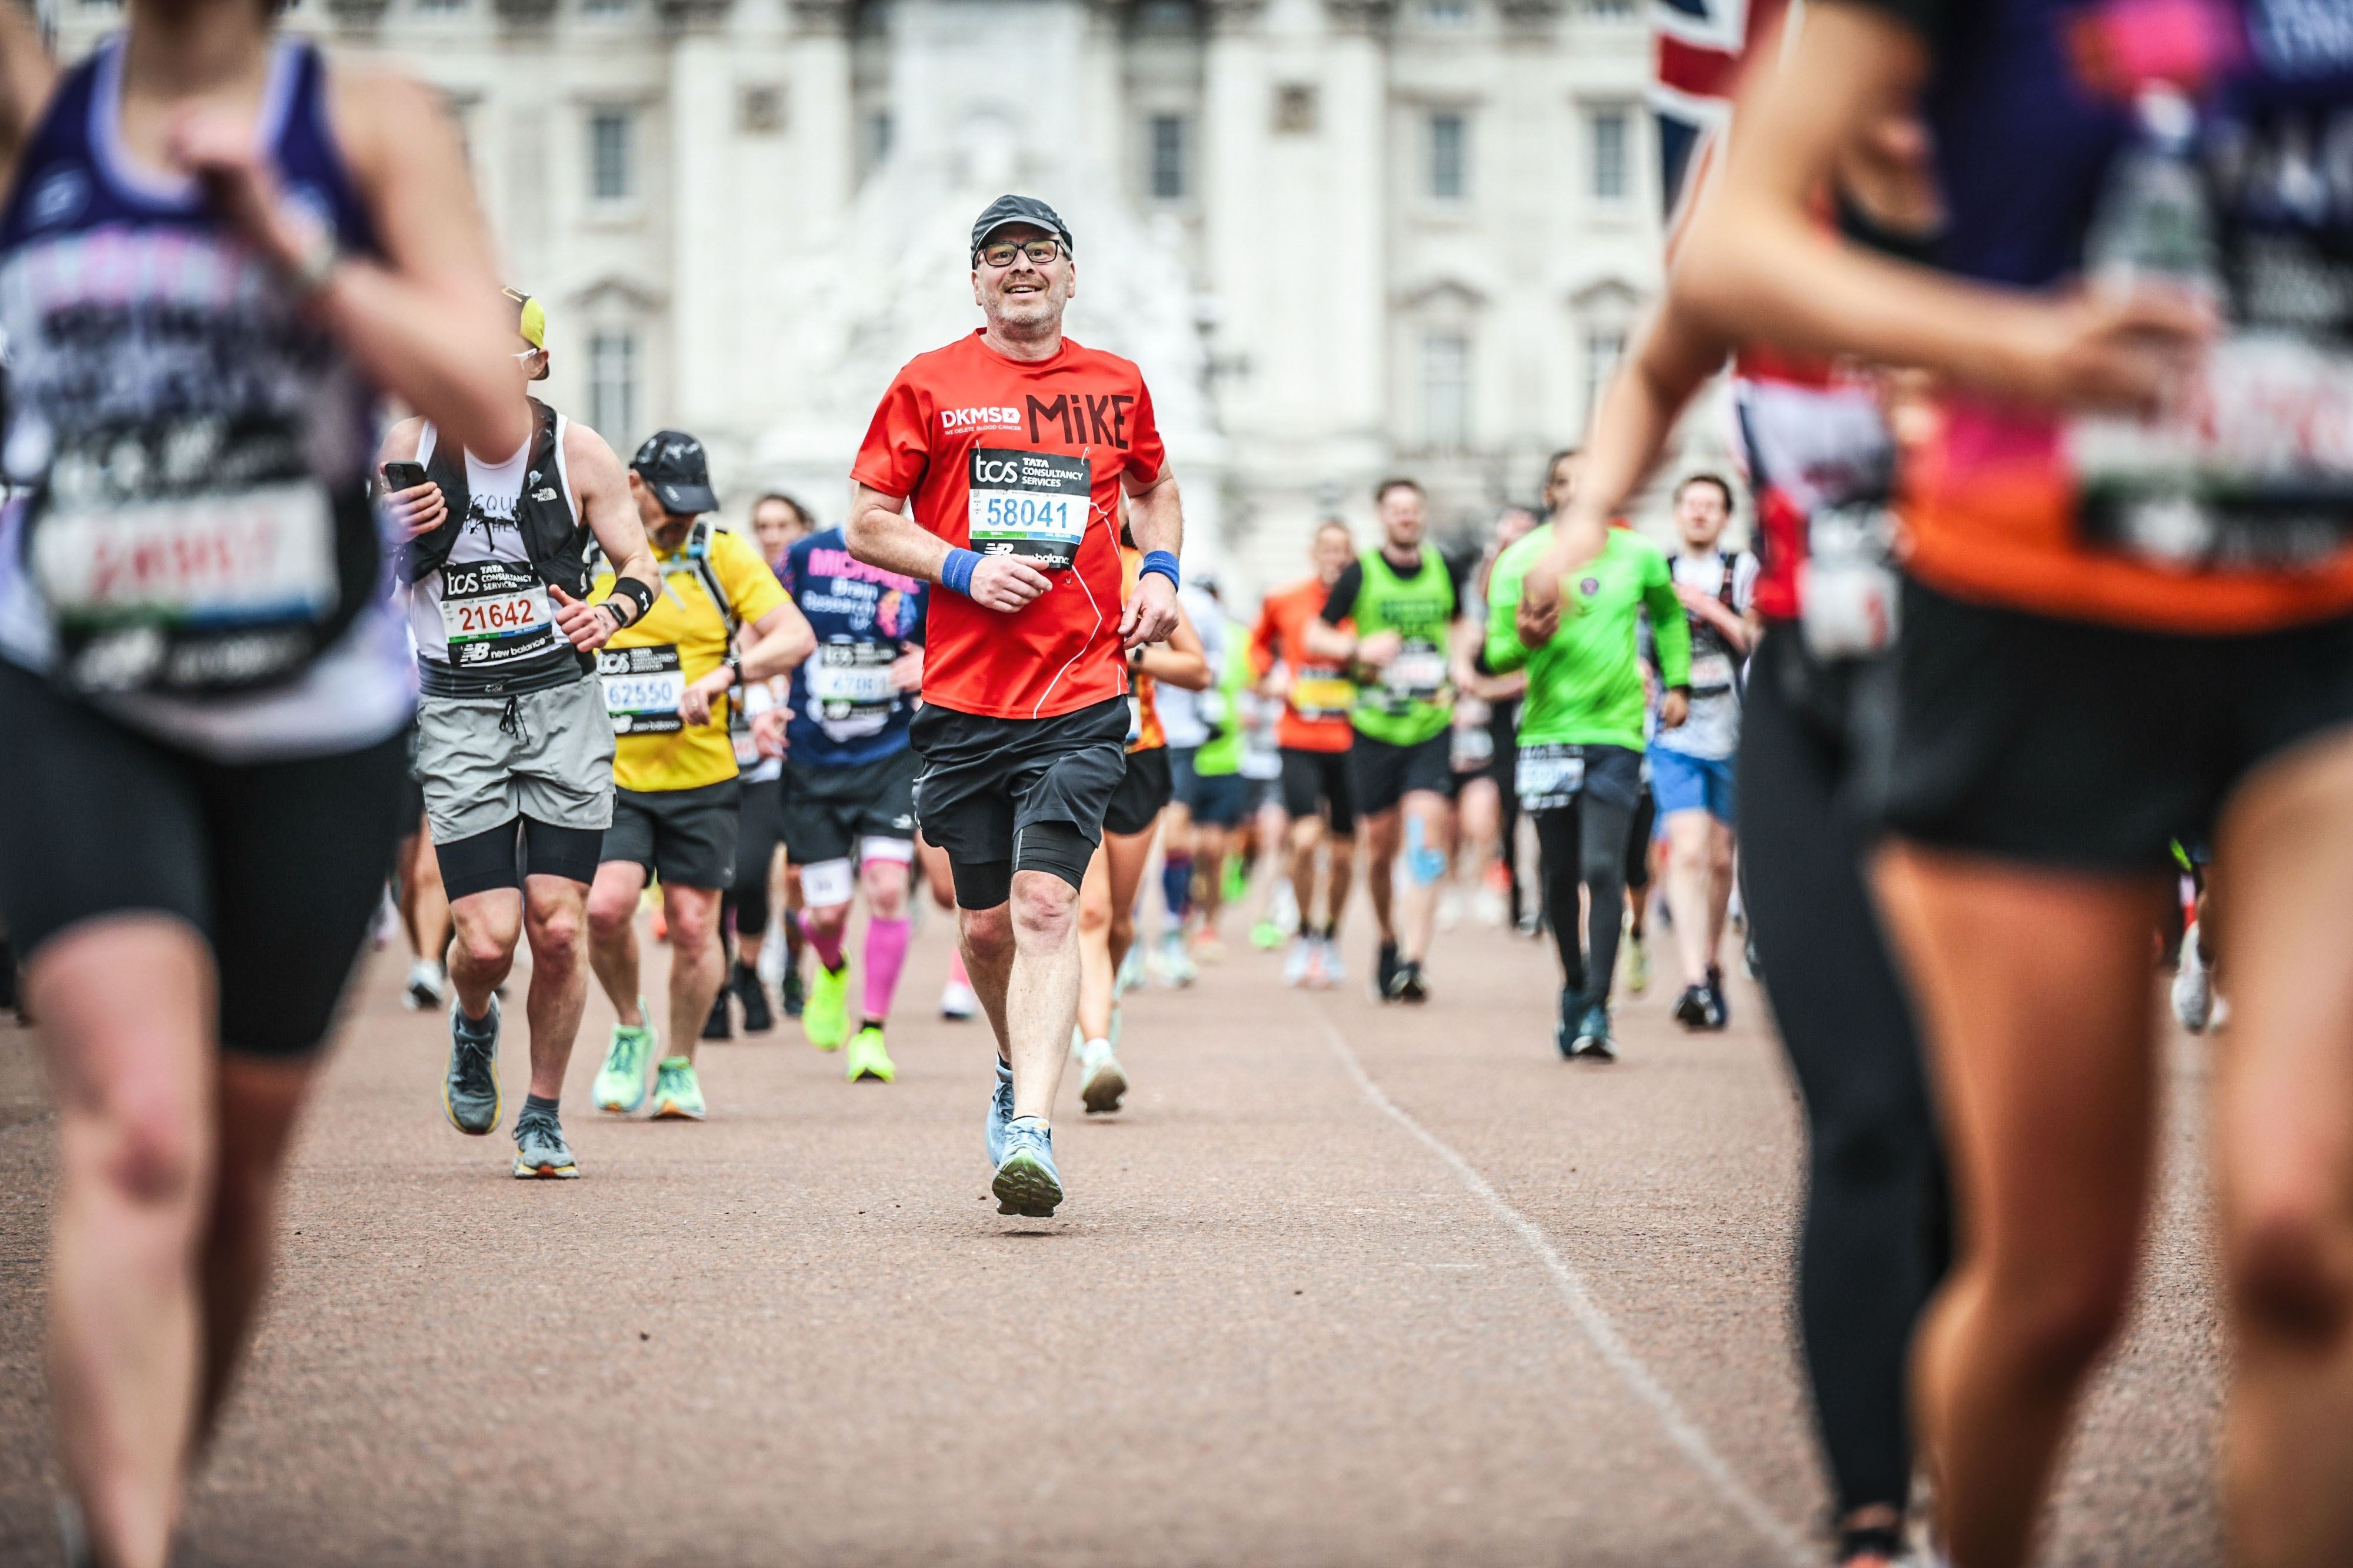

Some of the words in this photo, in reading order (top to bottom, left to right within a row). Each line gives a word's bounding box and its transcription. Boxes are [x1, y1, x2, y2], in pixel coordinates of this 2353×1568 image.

[941, 407, 1002, 428] DKMS
[975, 455, 1018, 483] tcs
[1022, 458, 1049, 468] TATA
[1021, 476, 1061, 488] SERVICES
[1022, 466, 1084, 481] CONSULTANCY
[987, 498, 1067, 529] 58041
[1035, 553, 1069, 565] balanc
[479, 565, 504, 574] TATA
[481, 572, 532, 582] CONSULTANCY
[447, 572, 479, 595] tcs
[483, 581, 518, 590] SERVICES
[459, 599, 534, 631] 21642
[491, 649, 509, 659] new
[511, 638, 546, 656] balance
[609, 680, 672, 705] 62550
